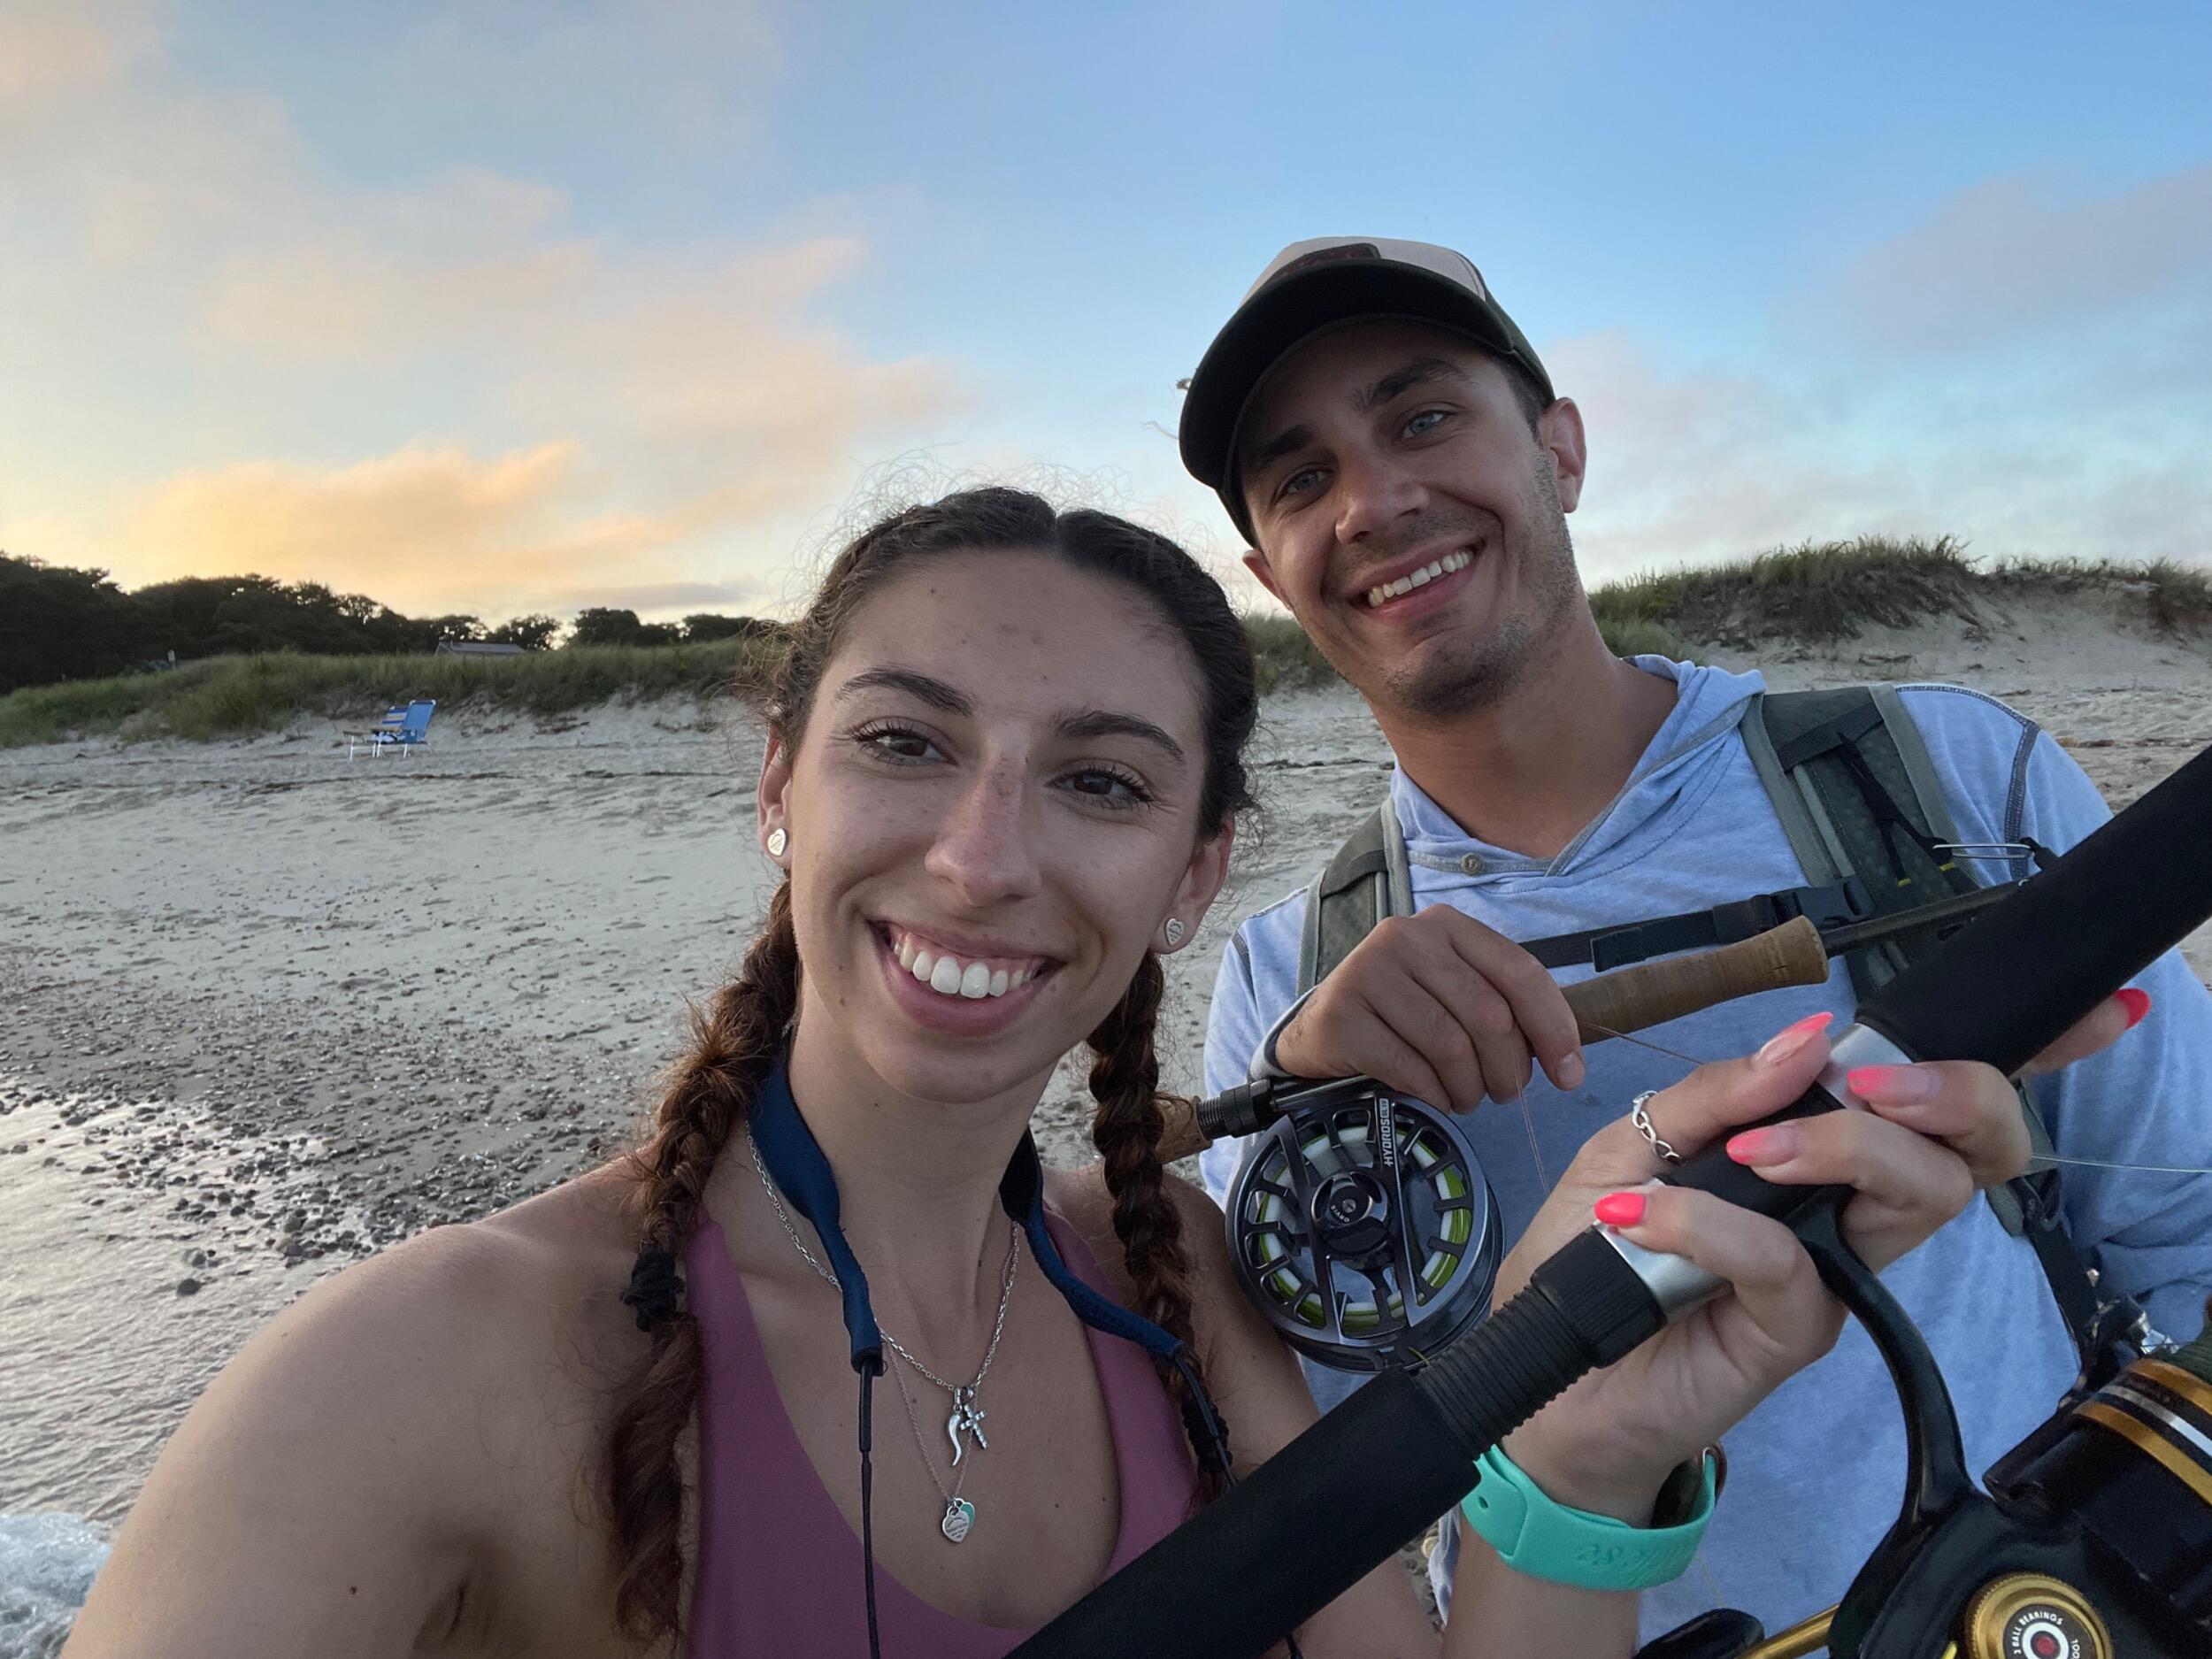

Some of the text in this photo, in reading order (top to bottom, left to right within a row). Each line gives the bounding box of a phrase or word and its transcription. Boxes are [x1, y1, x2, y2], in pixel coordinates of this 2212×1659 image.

[1380, 1119, 1394, 1166] HYDROS
[2012, 1626, 2022, 1647] BALL
[2018, 1611, 2063, 1625] BEARINGS
